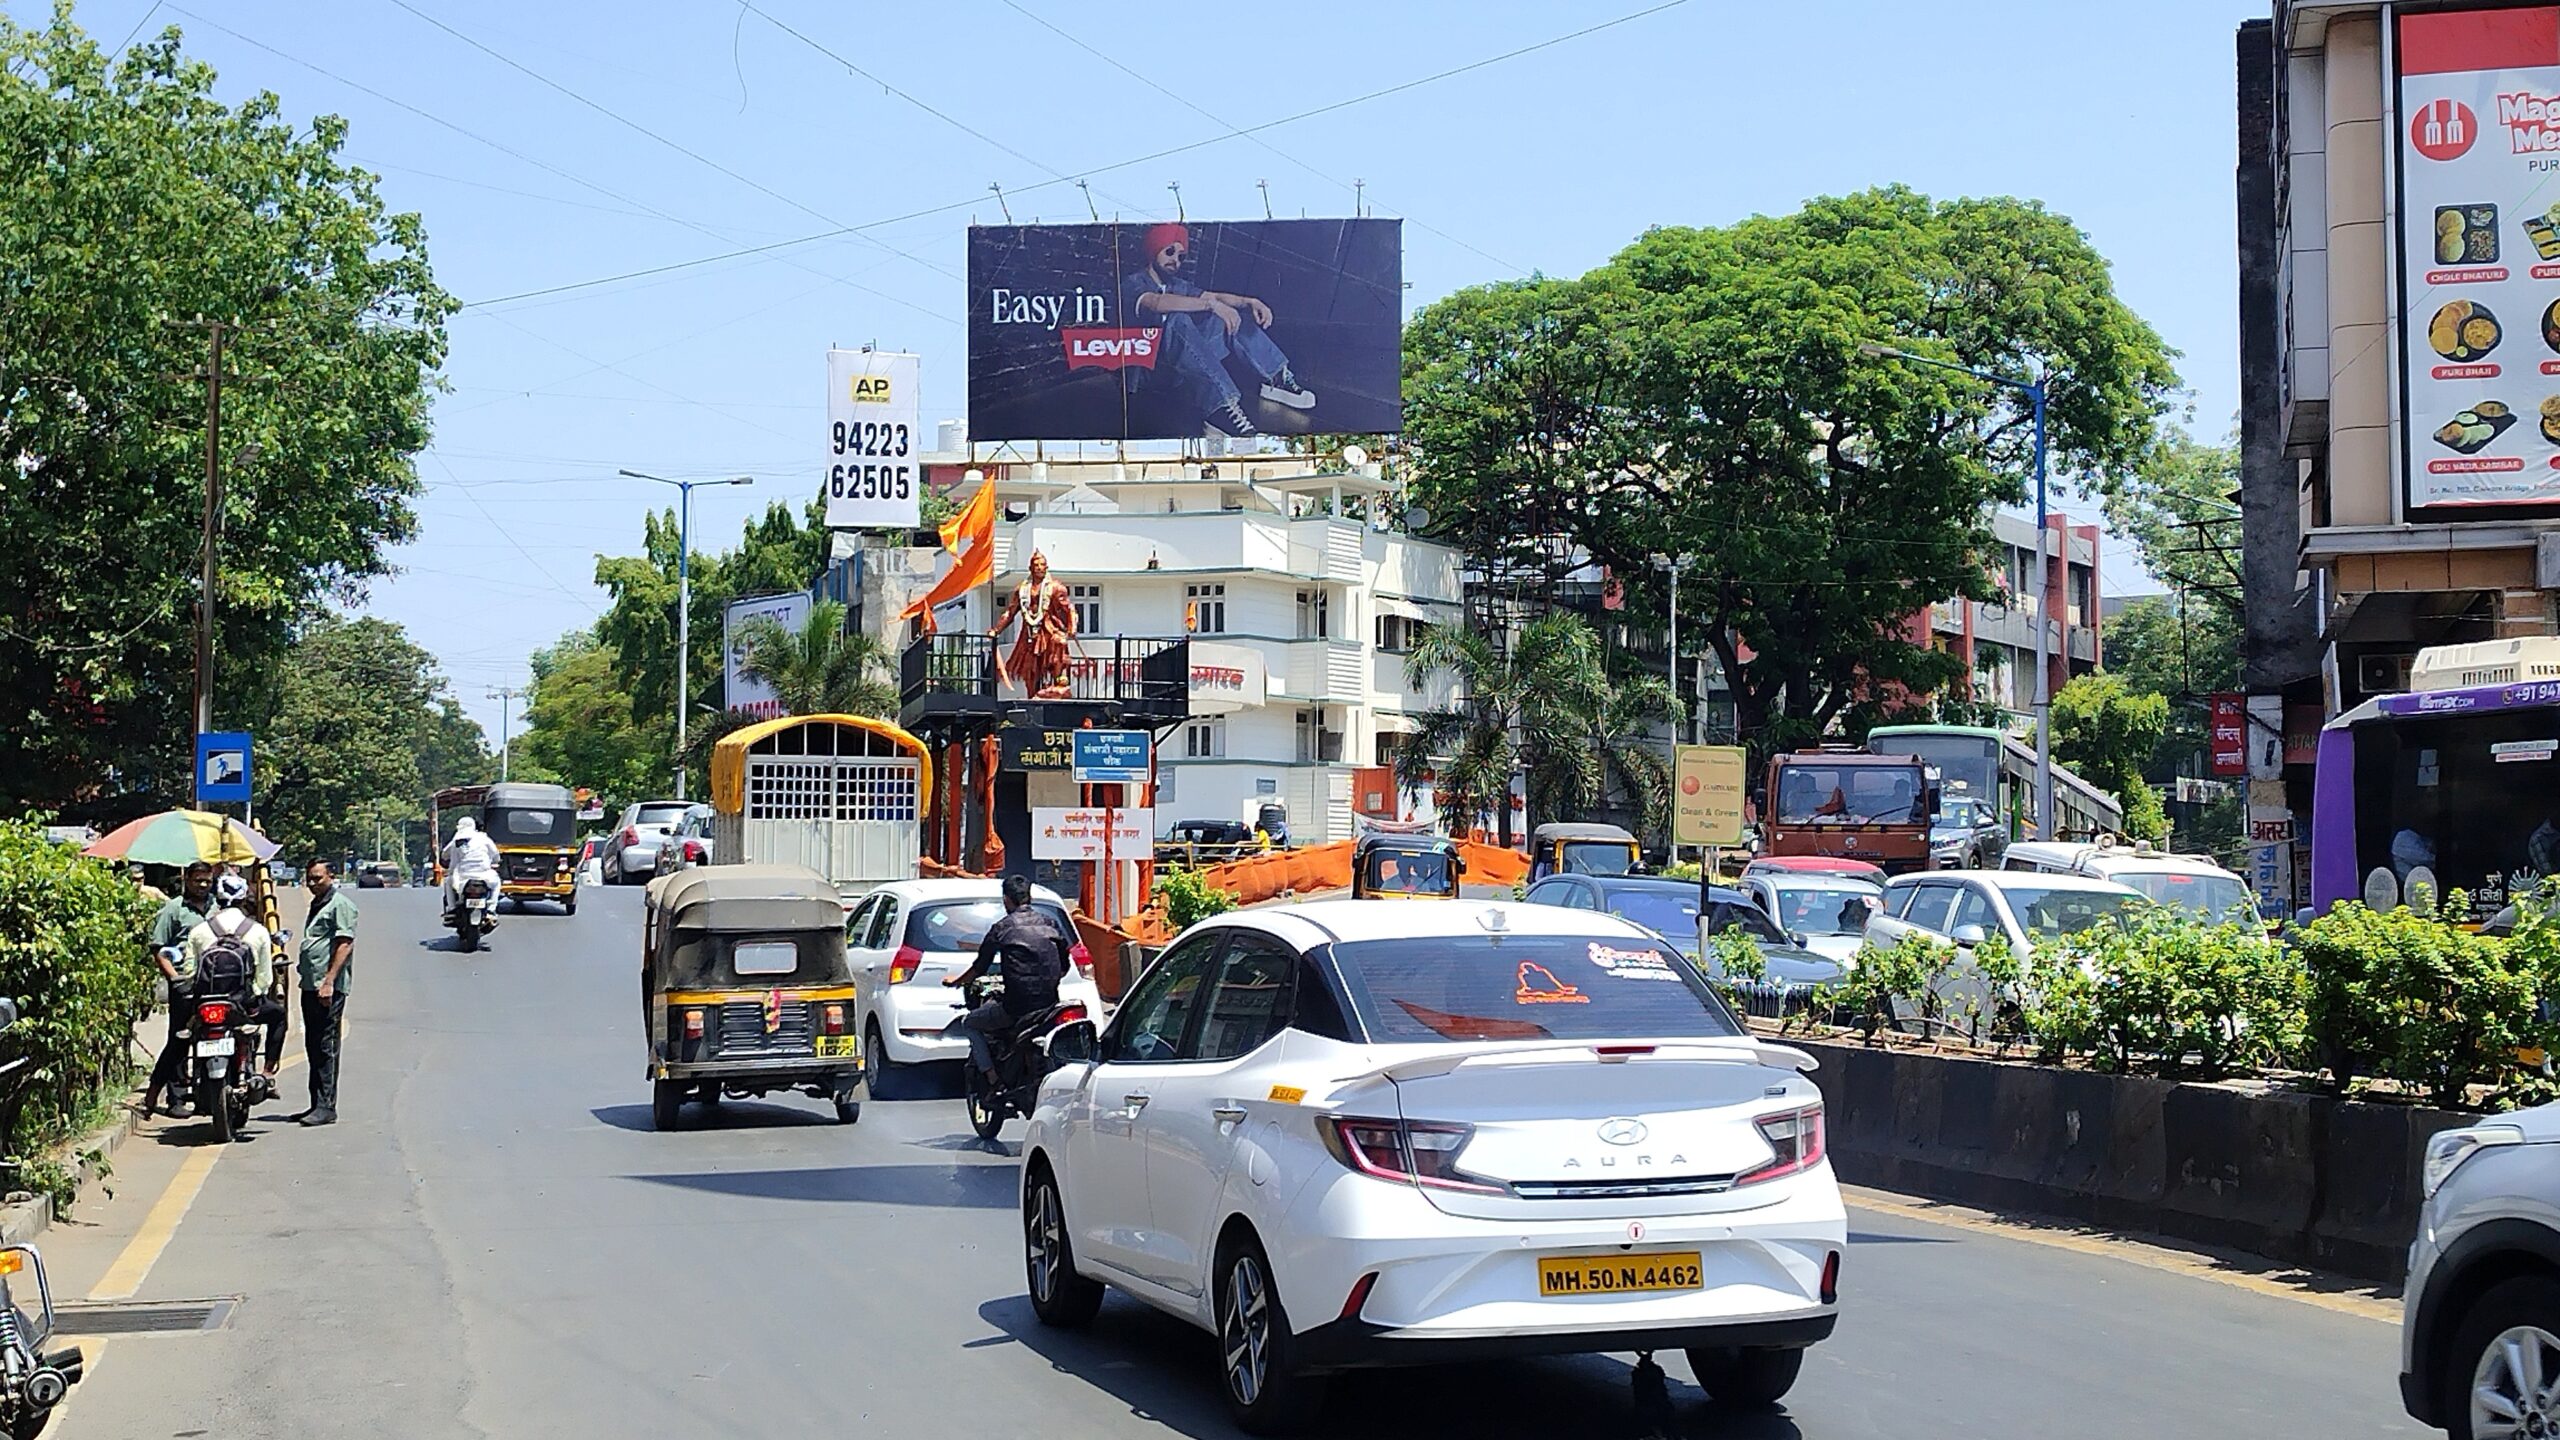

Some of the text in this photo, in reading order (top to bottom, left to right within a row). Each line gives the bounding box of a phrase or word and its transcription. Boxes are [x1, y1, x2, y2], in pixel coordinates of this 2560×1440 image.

[992, 287, 1106, 330] Easy in
[856, 379, 889, 395] AP
[833, 421, 908, 457] 94223
[831, 464, 909, 500] 62505
[2486, 870, 2503, 888] पुणे
[2479, 888, 2503, 902] सिटी
[1564, 1154, 1687, 1168] AURA
[1546, 1265, 1699, 1291] MH.50.N.4462
